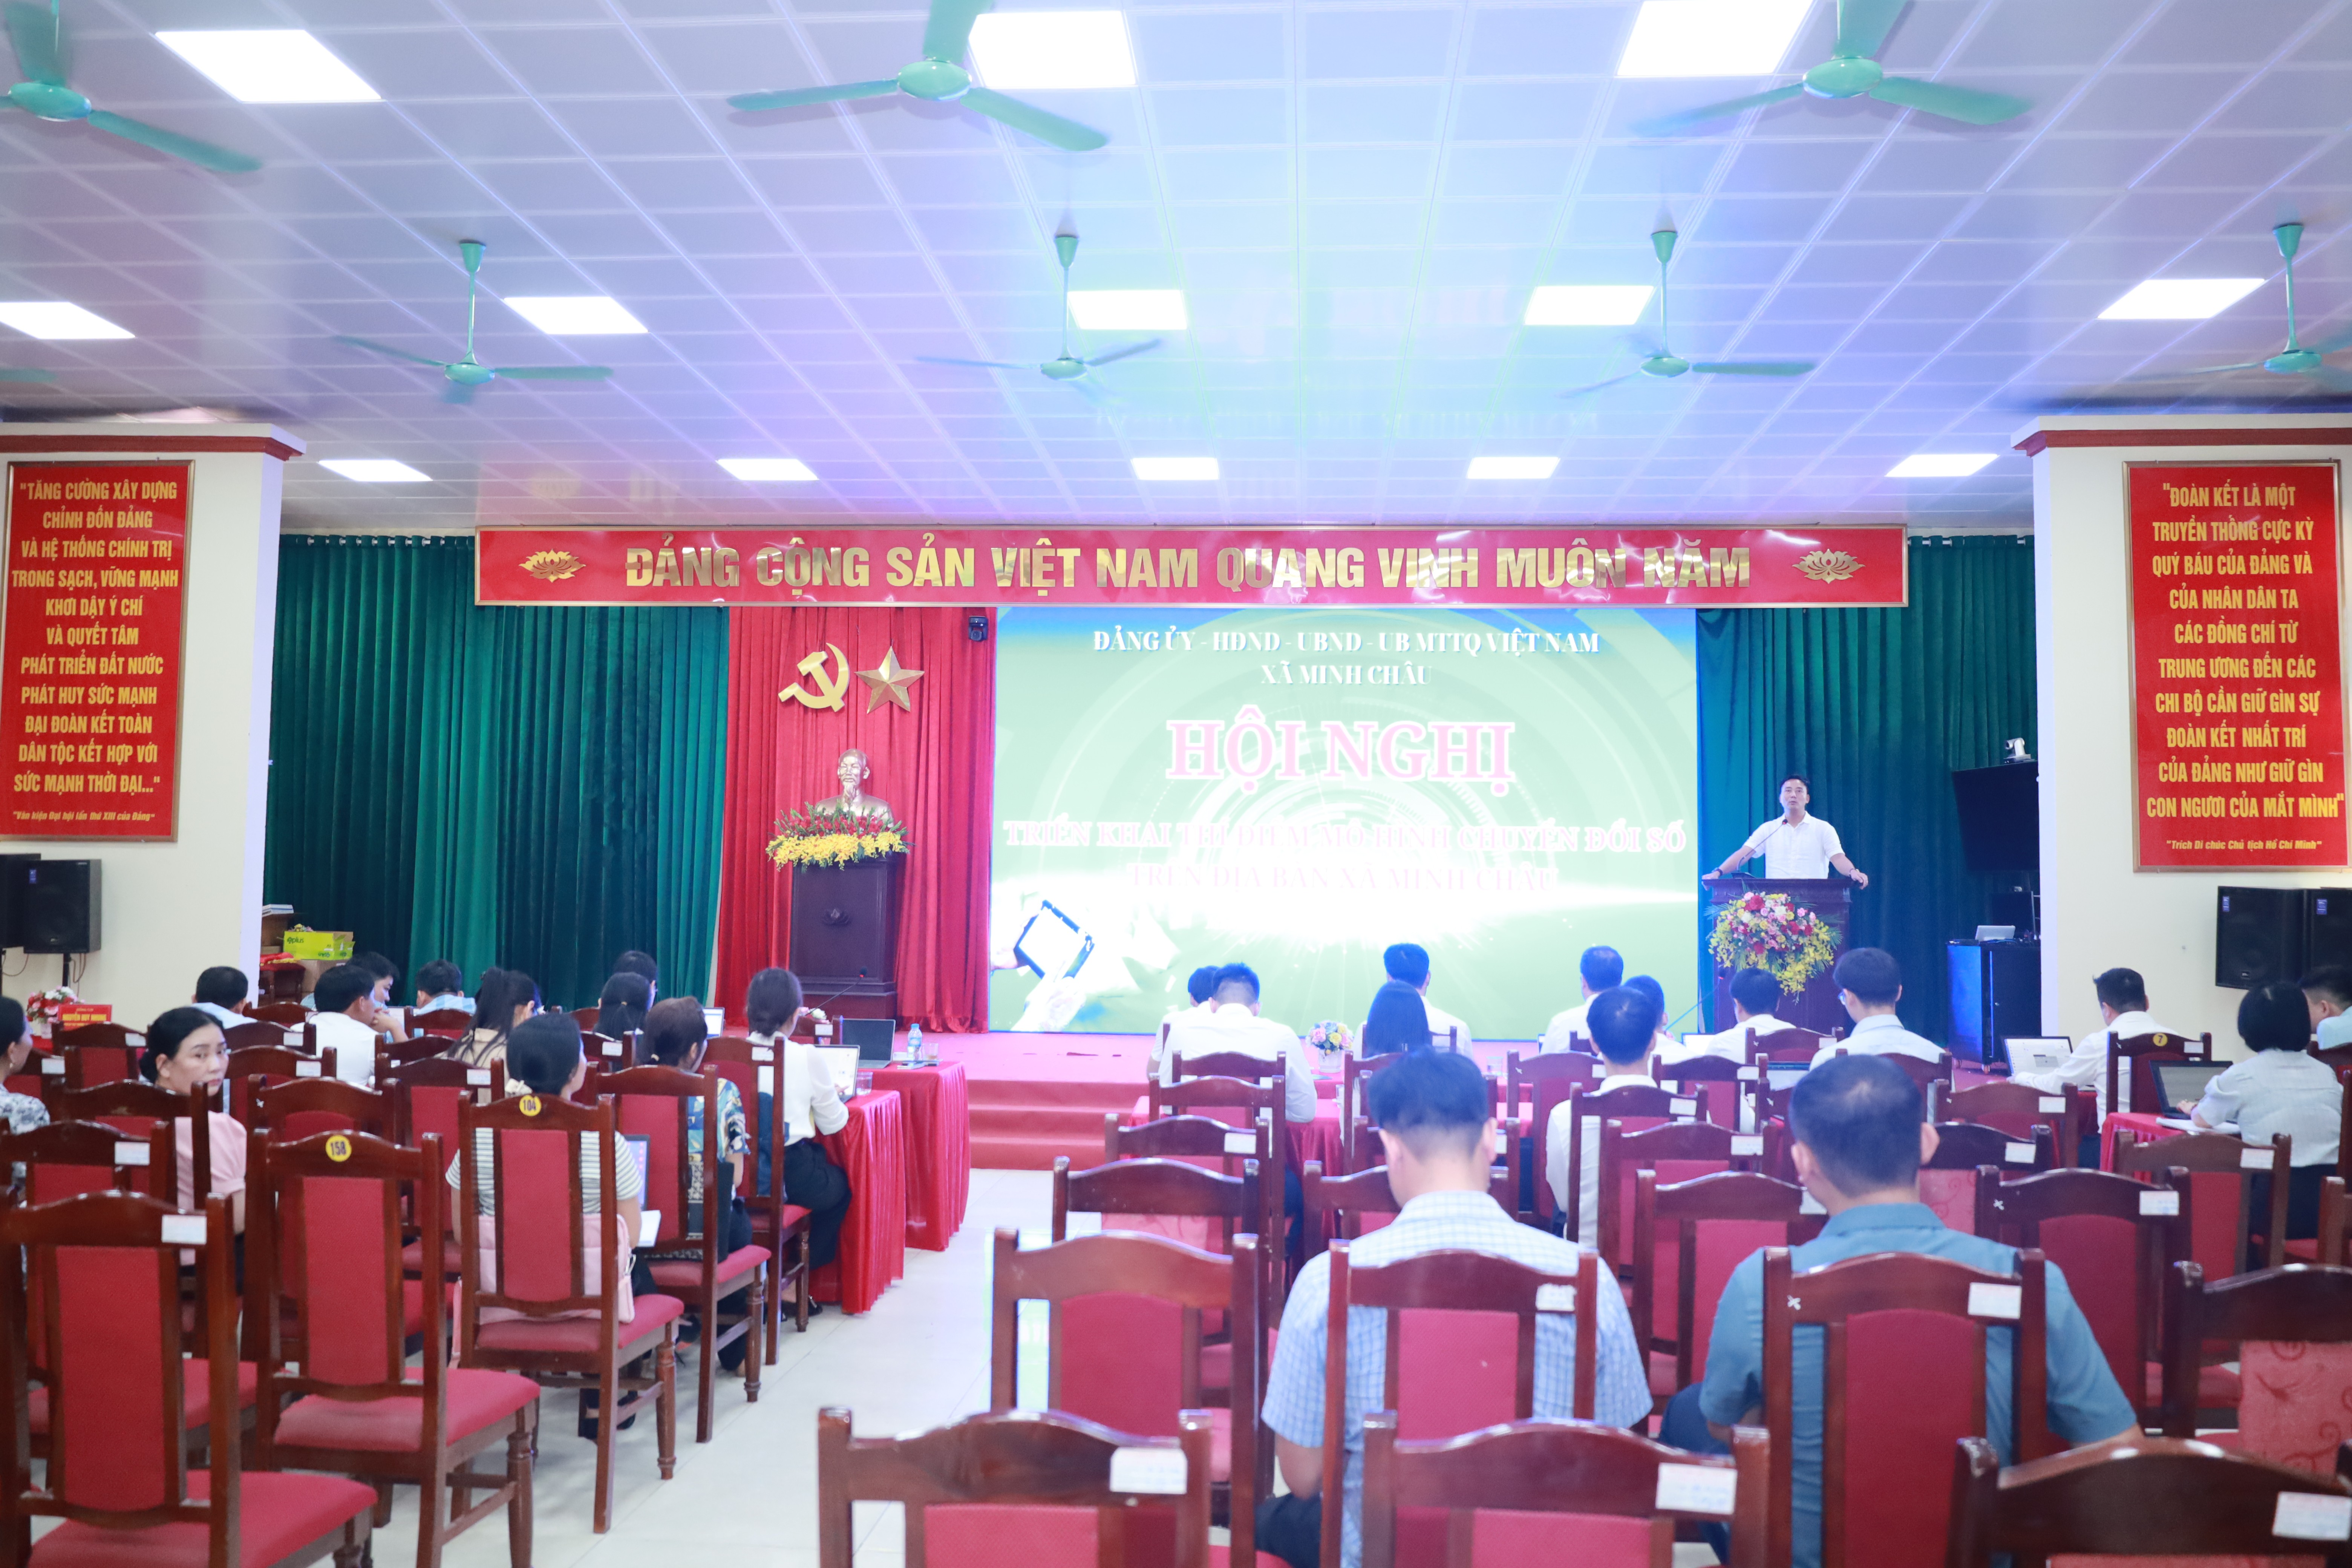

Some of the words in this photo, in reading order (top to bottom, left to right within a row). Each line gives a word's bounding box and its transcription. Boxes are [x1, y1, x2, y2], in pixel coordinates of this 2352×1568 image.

[20, 479, 61, 500] "TĂNG
[65, 478, 109, 500] CƯỜNG
[113, 479, 139, 500] XÂY
[141, 480, 178, 503] DỰNG
[2163, 482, 2210, 507] "ĐOÀN
[2213, 479, 2240, 507] KẾT
[2243, 483, 2262, 507] LÀ
[2265, 482, 2296, 510] MỘT
[43, 505, 83, 528] CHỈNH
[86, 505, 114, 528] ĐỐN
[116, 504, 153, 528] ĐẢNG
[2152, 514, 2207, 542] TRUYỀN
[2210, 514, 2259, 541] THỐNG
[2262, 519, 2291, 544] CỰC
[2295, 516, 2314, 541] KỲ
[21, 537, 38, 557] VÀ
[41, 537, 58, 561] HỆ
[62, 534, 106, 558] THỐNG
[108, 537, 149, 558] CHÍNH
[152, 540, 172, 561] TRỊ
[625, 532, 740, 587] ĐẢNG
[756, 537, 870, 596] CỘNG
[886, 532, 975, 587] SẢN
[991, 537, 1081, 596] VIỆT
[1096, 548, 1198, 588] NAM
[1217, 547, 1365, 592] QUANG
[1377, 548, 1479, 588] VINH
[1496, 537, 1626, 588] MUÔN
[1643, 539, 1750, 588] NĂM
[2152, 551, 2180, 577] QUÝ
[2184, 551, 2213, 575] BÁU
[2217, 548, 2246, 575] CỦA
[2249, 548, 2290, 574] ĐẢNG
[2293, 551, 2313, 574] VÀ
[12, 570, 55, 587] TRONG
[58, 570, 97, 591] SẠCH,
[100, 566, 136, 588] VỮNG
[139, 569, 179, 590] MẠNH
[46, 597, 77, 616] KHƠI
[80, 595, 106, 619] DẬY
[109, 595, 118, 616] Ý
[121, 595, 144, 616] CHÍ
[2169, 582, 2199, 609] CỦA
[2202, 585, 2243, 609] NHÂN
[2246, 585, 2277, 609] DÂN
[2280, 589, 2299, 609] TA
[46, 624, 63, 645] VÀ
[67, 621, 108, 647] QUYẾT
[110, 624, 139, 645] TÂM
[1093, 625, 1160, 651] ĐẢNG
[1165, 625, 1196, 651] ỦY
[1213, 632, 1280, 651] HĐND
[1297, 632, 1362, 651] UBND
[1378, 632, 1410, 652] UB
[1416, 632, 1482, 657] MTTQ
[1486, 628, 1540, 657] VIỆT
[1544, 632, 1600, 652] NAM
[2174, 620, 2203, 644] CÁC
[2207, 615, 2247, 644] ĐỒNG
[2251, 620, 2275, 644] CHÍ
[2278, 619, 2299, 643] TỪ
[21, 653, 55, 674] PHÁT
[58, 649, 96, 675] TRIỂN
[99, 651, 125, 675] ĐẤT
[127, 652, 164, 675] NƯỚC
[1260, 660, 1293, 684] XÃ
[1298, 665, 1362, 684] MINH
[1367, 660, 1432, 684] CHÂU
[2158, 658, 2206, 678] TRUNG
[2210, 656, 2249, 678] ƯƠNG
[2252, 651, 2283, 678] ĐẾN
[2286, 654, 2316, 678] CÁC
[21, 683, 56, 704] PHÁT
[58, 686, 85, 704] HUY
[87, 682, 115, 704] SỨC
[118, 686, 158, 707] MẠNH
[2155, 693, 2179, 713] CHI
[2184, 689, 2203, 717] BỘ
[2207, 685, 2237, 713] CẦN
[2241, 688, 2267, 713] GIỮ
[2269, 689, 2295, 713] GÌN
[2299, 691, 2321, 716] SỰ
[25, 715, 47, 736] ĐẠI
[51, 712, 87, 733] ĐOÀN
[90, 709, 115, 733] KẾT
[118, 712, 153, 734] TOÀN
[2166, 723, 2207, 748] ĐOÀN
[2210, 719, 2236, 747] KẾT
[2242, 720, 2280, 747] NHẤT
[2283, 724, 2306, 747] TRÍ
[18, 741, 47, 762] DÂN
[50, 741, 75, 765] TỘC
[78, 738, 103, 763] KẾT
[106, 743, 133, 766] HỢP
[136, 741, 158, 763] VỚI
[1166, 704, 1306, 795] HỘI
[1320, 721, 1516, 797] NGHỊ
[2159, 755, 2188, 782] CỦA
[2191, 755, 2232, 782] ĐẢNG
[2235, 761, 2268, 783] NHƯ
[2269, 758, 2295, 782] GIỮ
[2297, 758, 2324, 782] GÌN
[14, 770, 41, 792] SỨC
[44, 774, 84, 795] MẠNH
[87, 770, 117, 793] THỜI
[120, 775, 161, 796] ĐẠI..."
[2147, 797, 2177, 818] CON
[2181, 795, 2225, 818] NGƯƠI
[2230, 790, 2259, 818] CỦA
[2263, 790, 2295, 818] MẮT
[2298, 793, 2344, 818] MÌNH"
[1096, 821, 1172, 847] KHAI
[2158, 1035, 2163, 1044] 7
